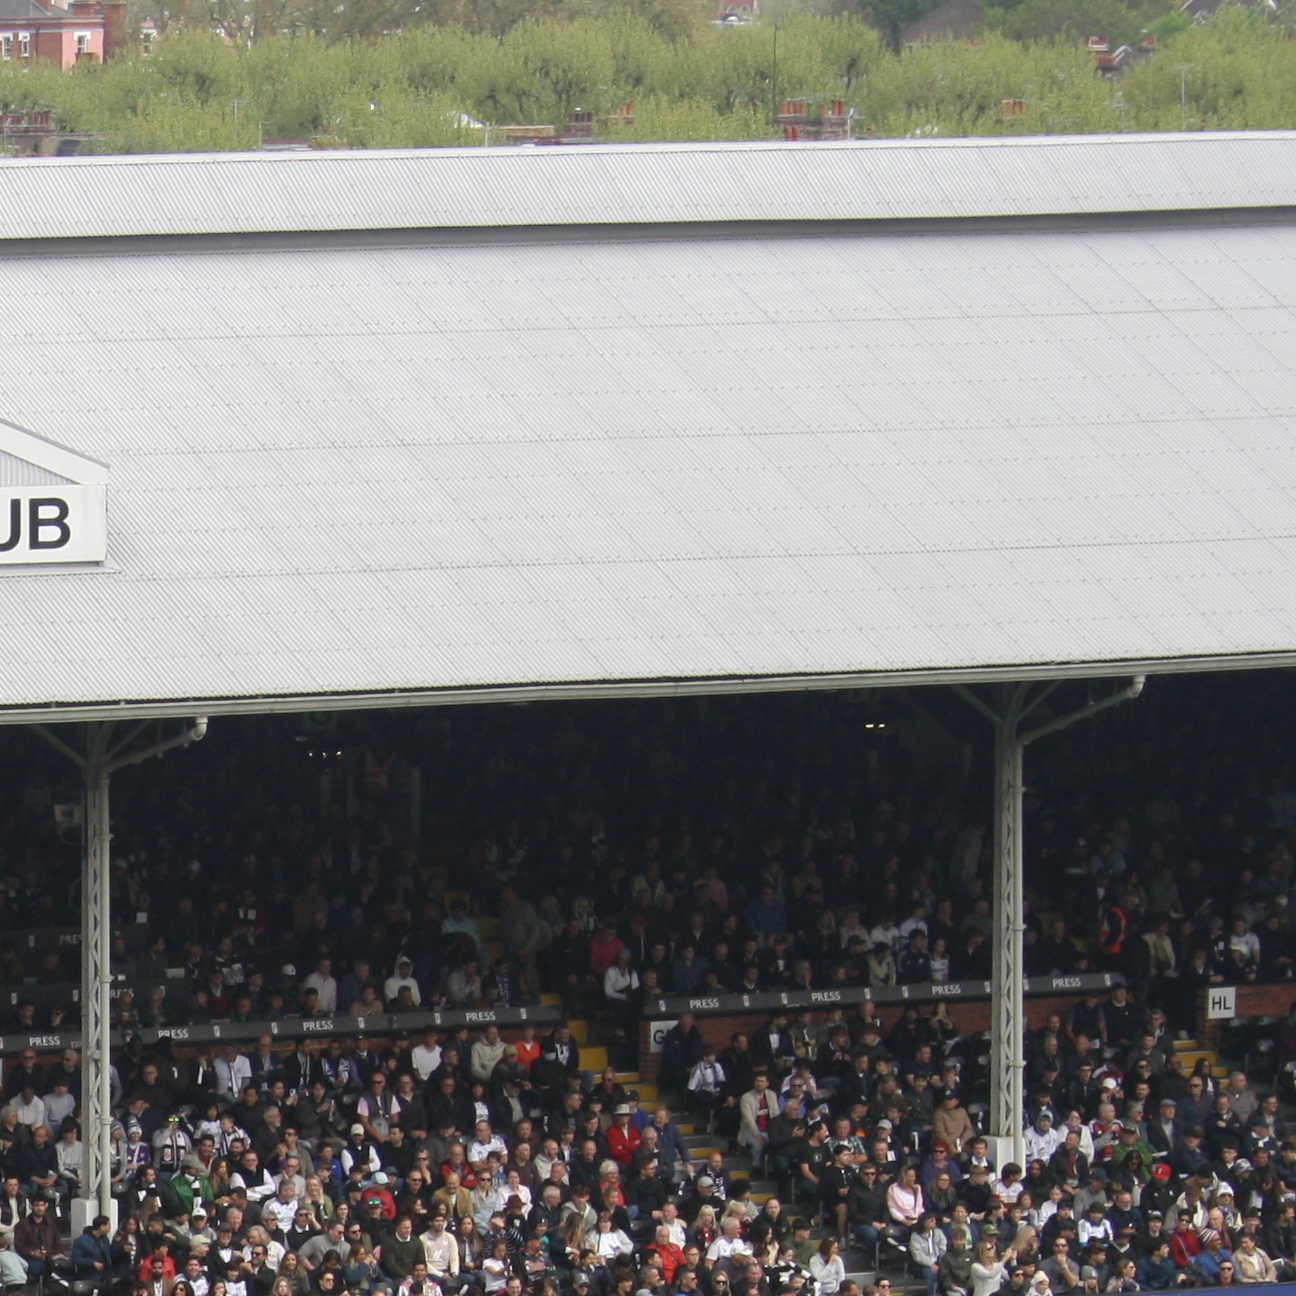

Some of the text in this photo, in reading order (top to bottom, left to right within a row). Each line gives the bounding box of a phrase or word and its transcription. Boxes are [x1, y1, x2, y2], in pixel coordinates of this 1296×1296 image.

[1053, 977, 1081, 989] PRESS
[932, 984, 961, 996] PRESS
[811, 991, 841, 1002] PRESS
[689, 998, 720, 1010] PRESS
[1212, 996, 1232, 1011] HL
[466, 1011, 496, 1022] PRESS
[303, 1020, 334, 1032] PRESS
[158, 1029, 189, 1040] PRESS
[29, 1035, 60, 1047] PRESS
